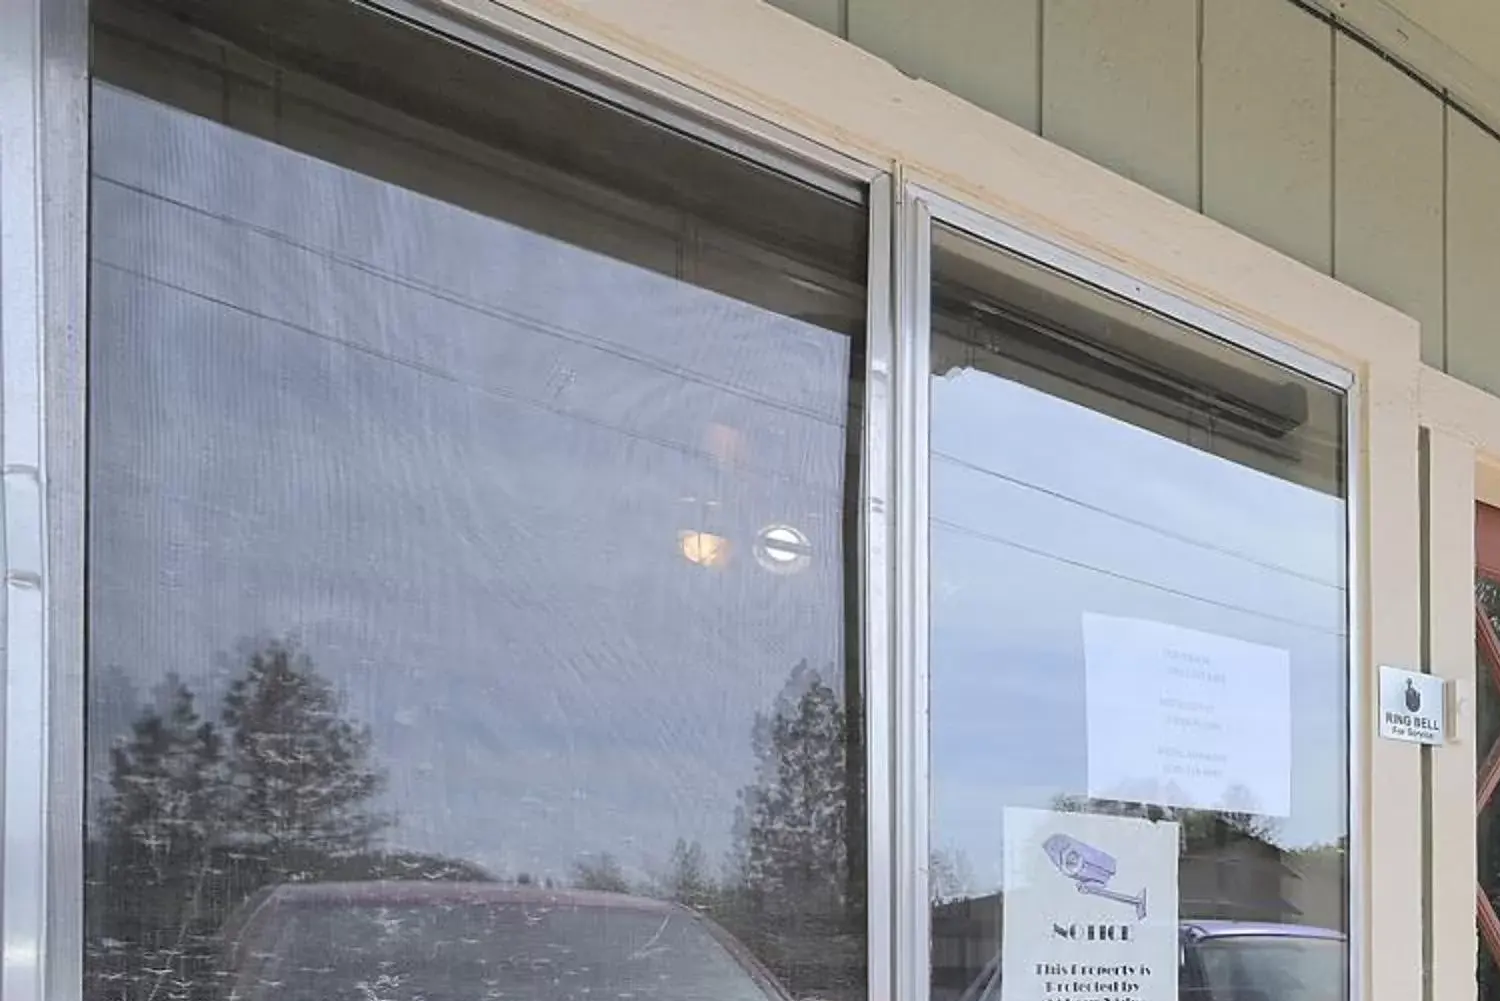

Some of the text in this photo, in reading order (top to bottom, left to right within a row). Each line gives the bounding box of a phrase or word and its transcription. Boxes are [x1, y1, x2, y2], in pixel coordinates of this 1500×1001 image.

[1385, 711, 1440, 731] RING BELL
[1051, 922, 1134, 941] NOTICE
[1036, 963, 1152, 977] This Property is
[1045, 980, 1119, 993] Protected
